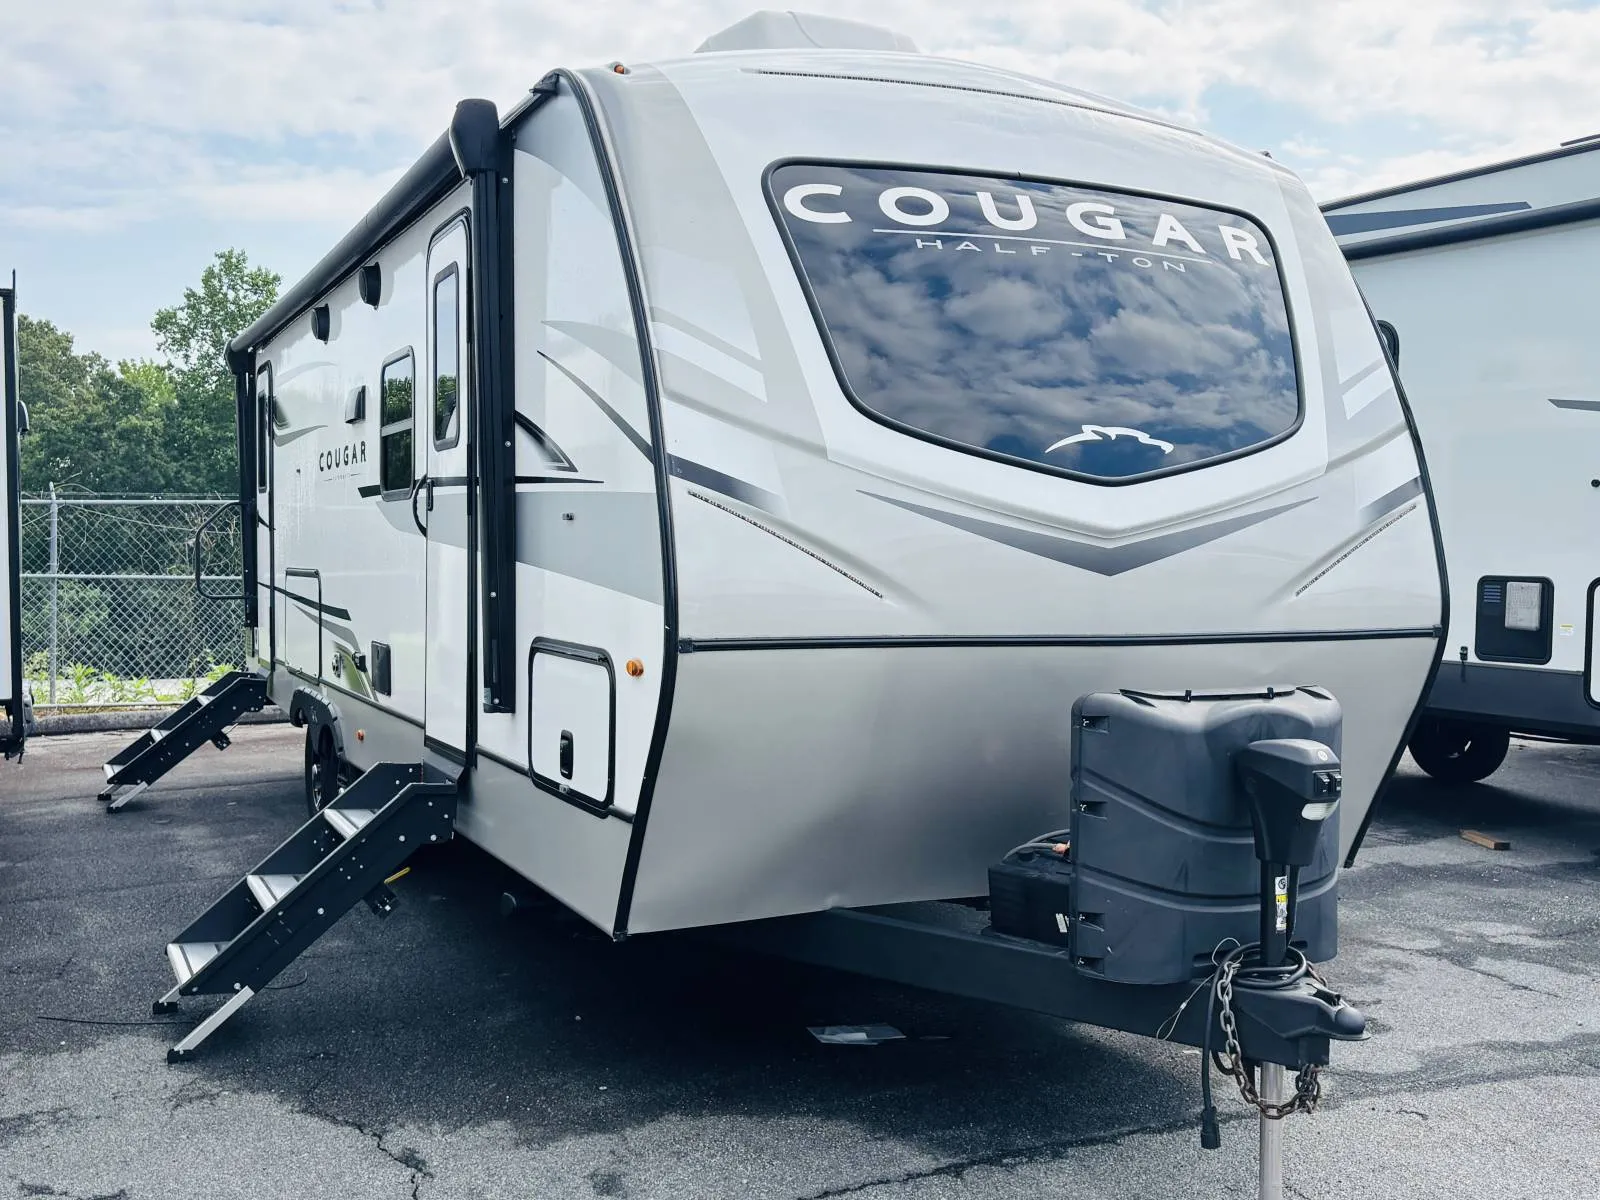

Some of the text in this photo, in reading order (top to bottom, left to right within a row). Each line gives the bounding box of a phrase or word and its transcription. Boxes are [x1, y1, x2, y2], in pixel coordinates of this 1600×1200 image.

[784, 183, 1271, 267] COUGAR
[915, 238, 1186, 273] HALF-TON
[319, 440, 366, 472] COUGAR
